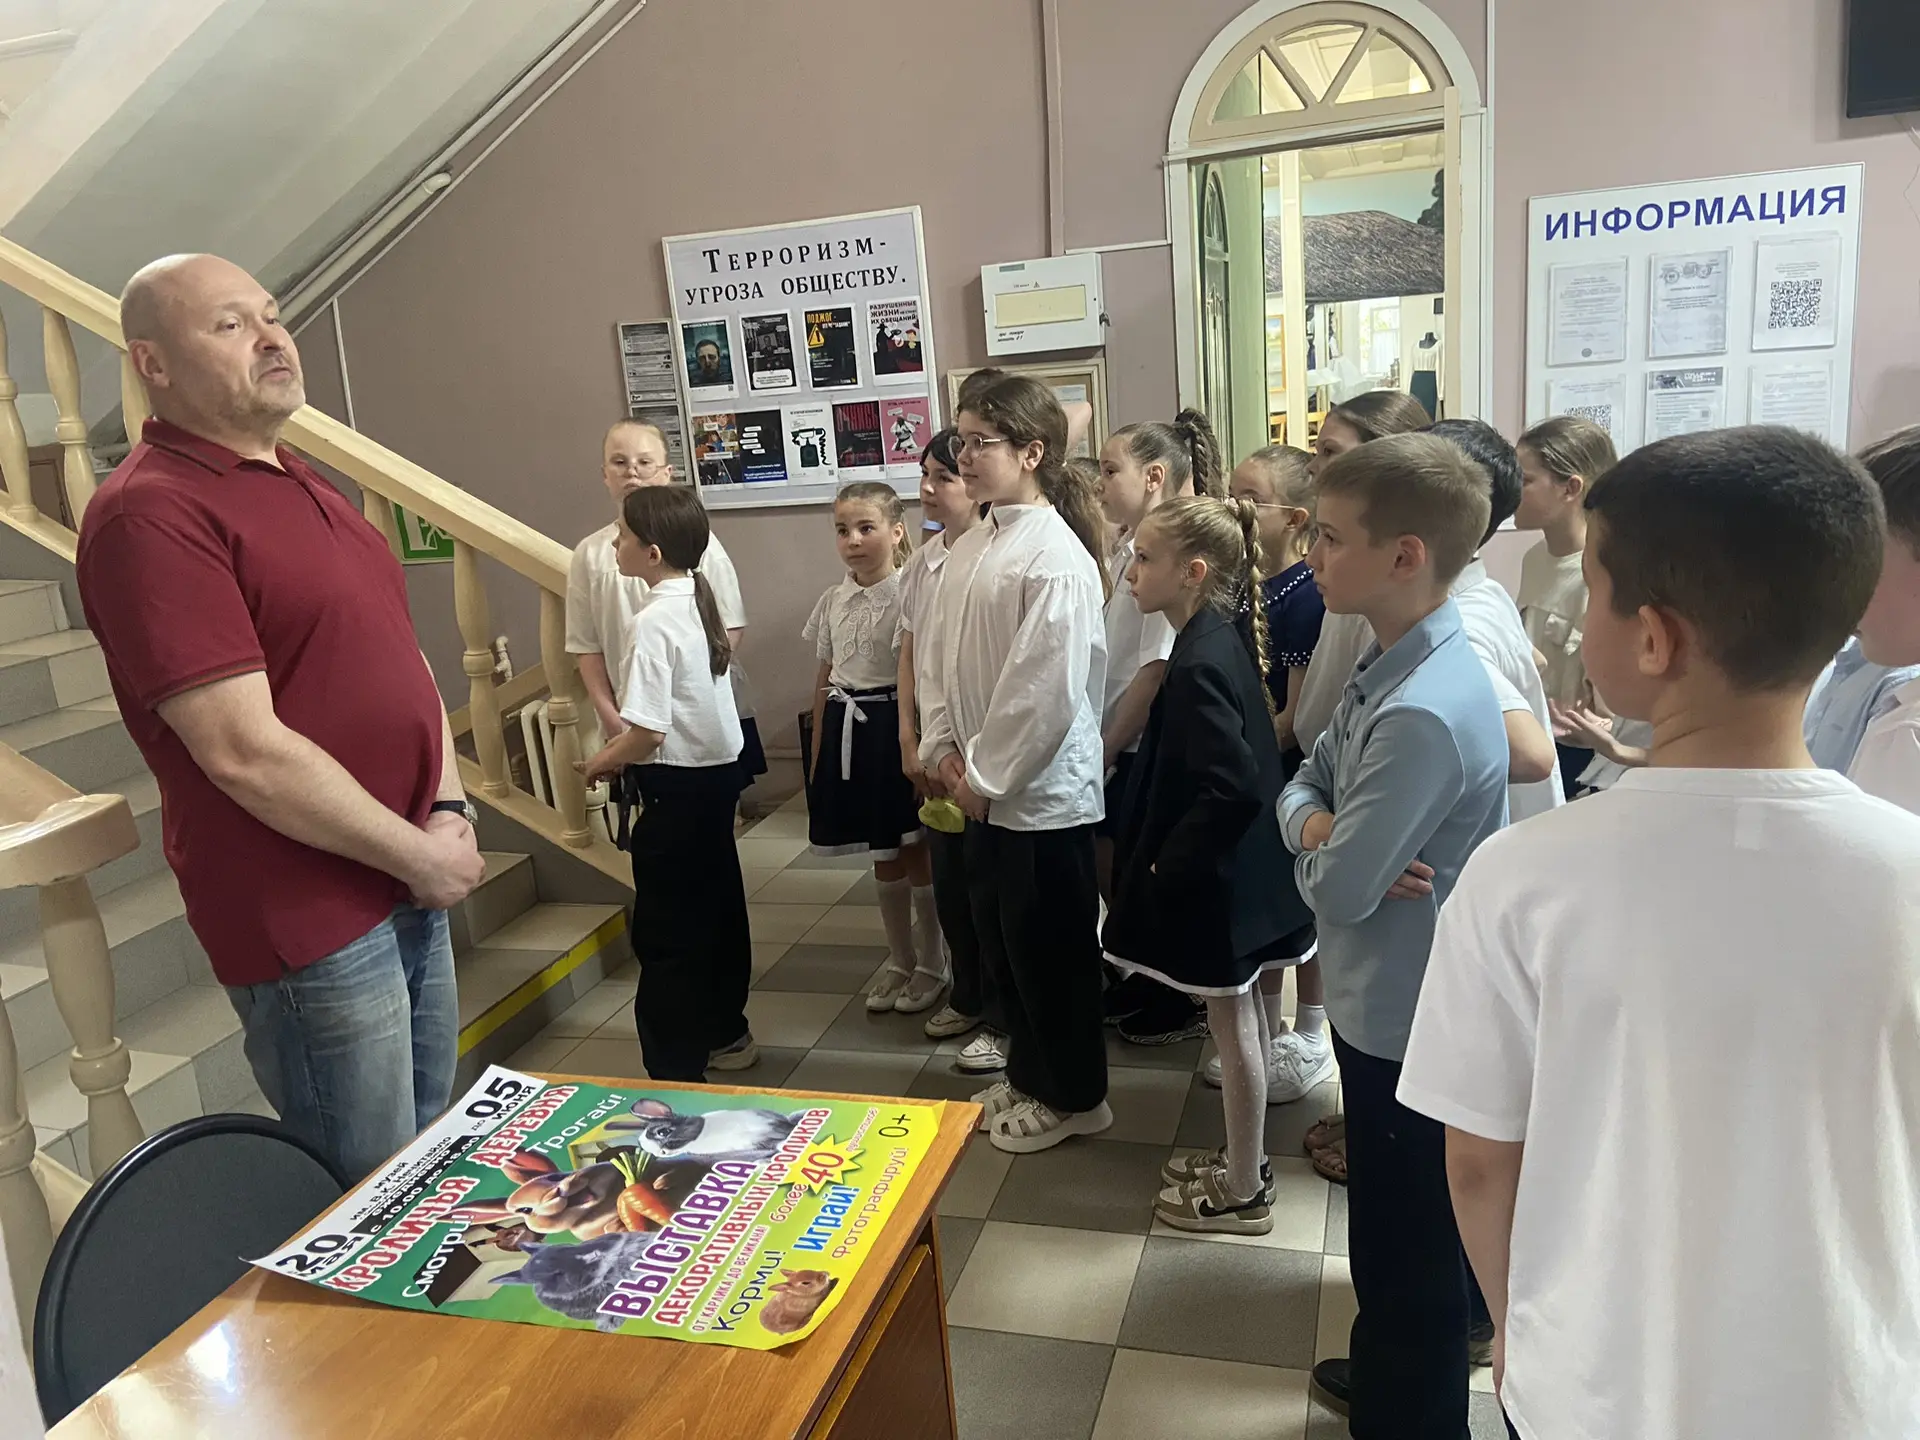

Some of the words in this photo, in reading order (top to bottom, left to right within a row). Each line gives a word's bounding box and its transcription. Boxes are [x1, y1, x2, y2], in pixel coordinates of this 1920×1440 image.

[1545, 185, 1846, 241] ИНФОРМАЦИЯ
[685, 282, 764, 305] УГРОЗА
[781, 266, 906, 297] ОБЩЕСТВУ.
[870, 309, 899, 318] ЖИЗНИ
[465, 1077, 523, 1119] 05
[525, 1093, 627, 1153] Трогай!
[879, 1114, 911, 1137] 0+
[324, 1177, 479, 1290] КРОЛИЧЬЯ
[468, 1086, 577, 1167] ДЕРЕВНЯ
[372, 1149, 450, 1217] ежедневно
[382, 1186, 423, 1221] 10.00
[425, 1168, 443, 1185] до
[443, 1136, 480, 1166] 18.00
[770, 1184, 807, 1221] более
[801, 1152, 844, 1184] 40
[599, 1163, 757, 1317] ВЫСТАВКА
[654, 1186, 776, 1326] ДЕКОРАТИВНЫХ
[759, 1109, 830, 1182] КРОЛИКОВ
[795, 1186, 860, 1251] Играй!
[276, 1234, 348, 1272] 20
[402, 1213, 475, 1298] Смотри!
[711, 1250, 786, 1331] Корми!
